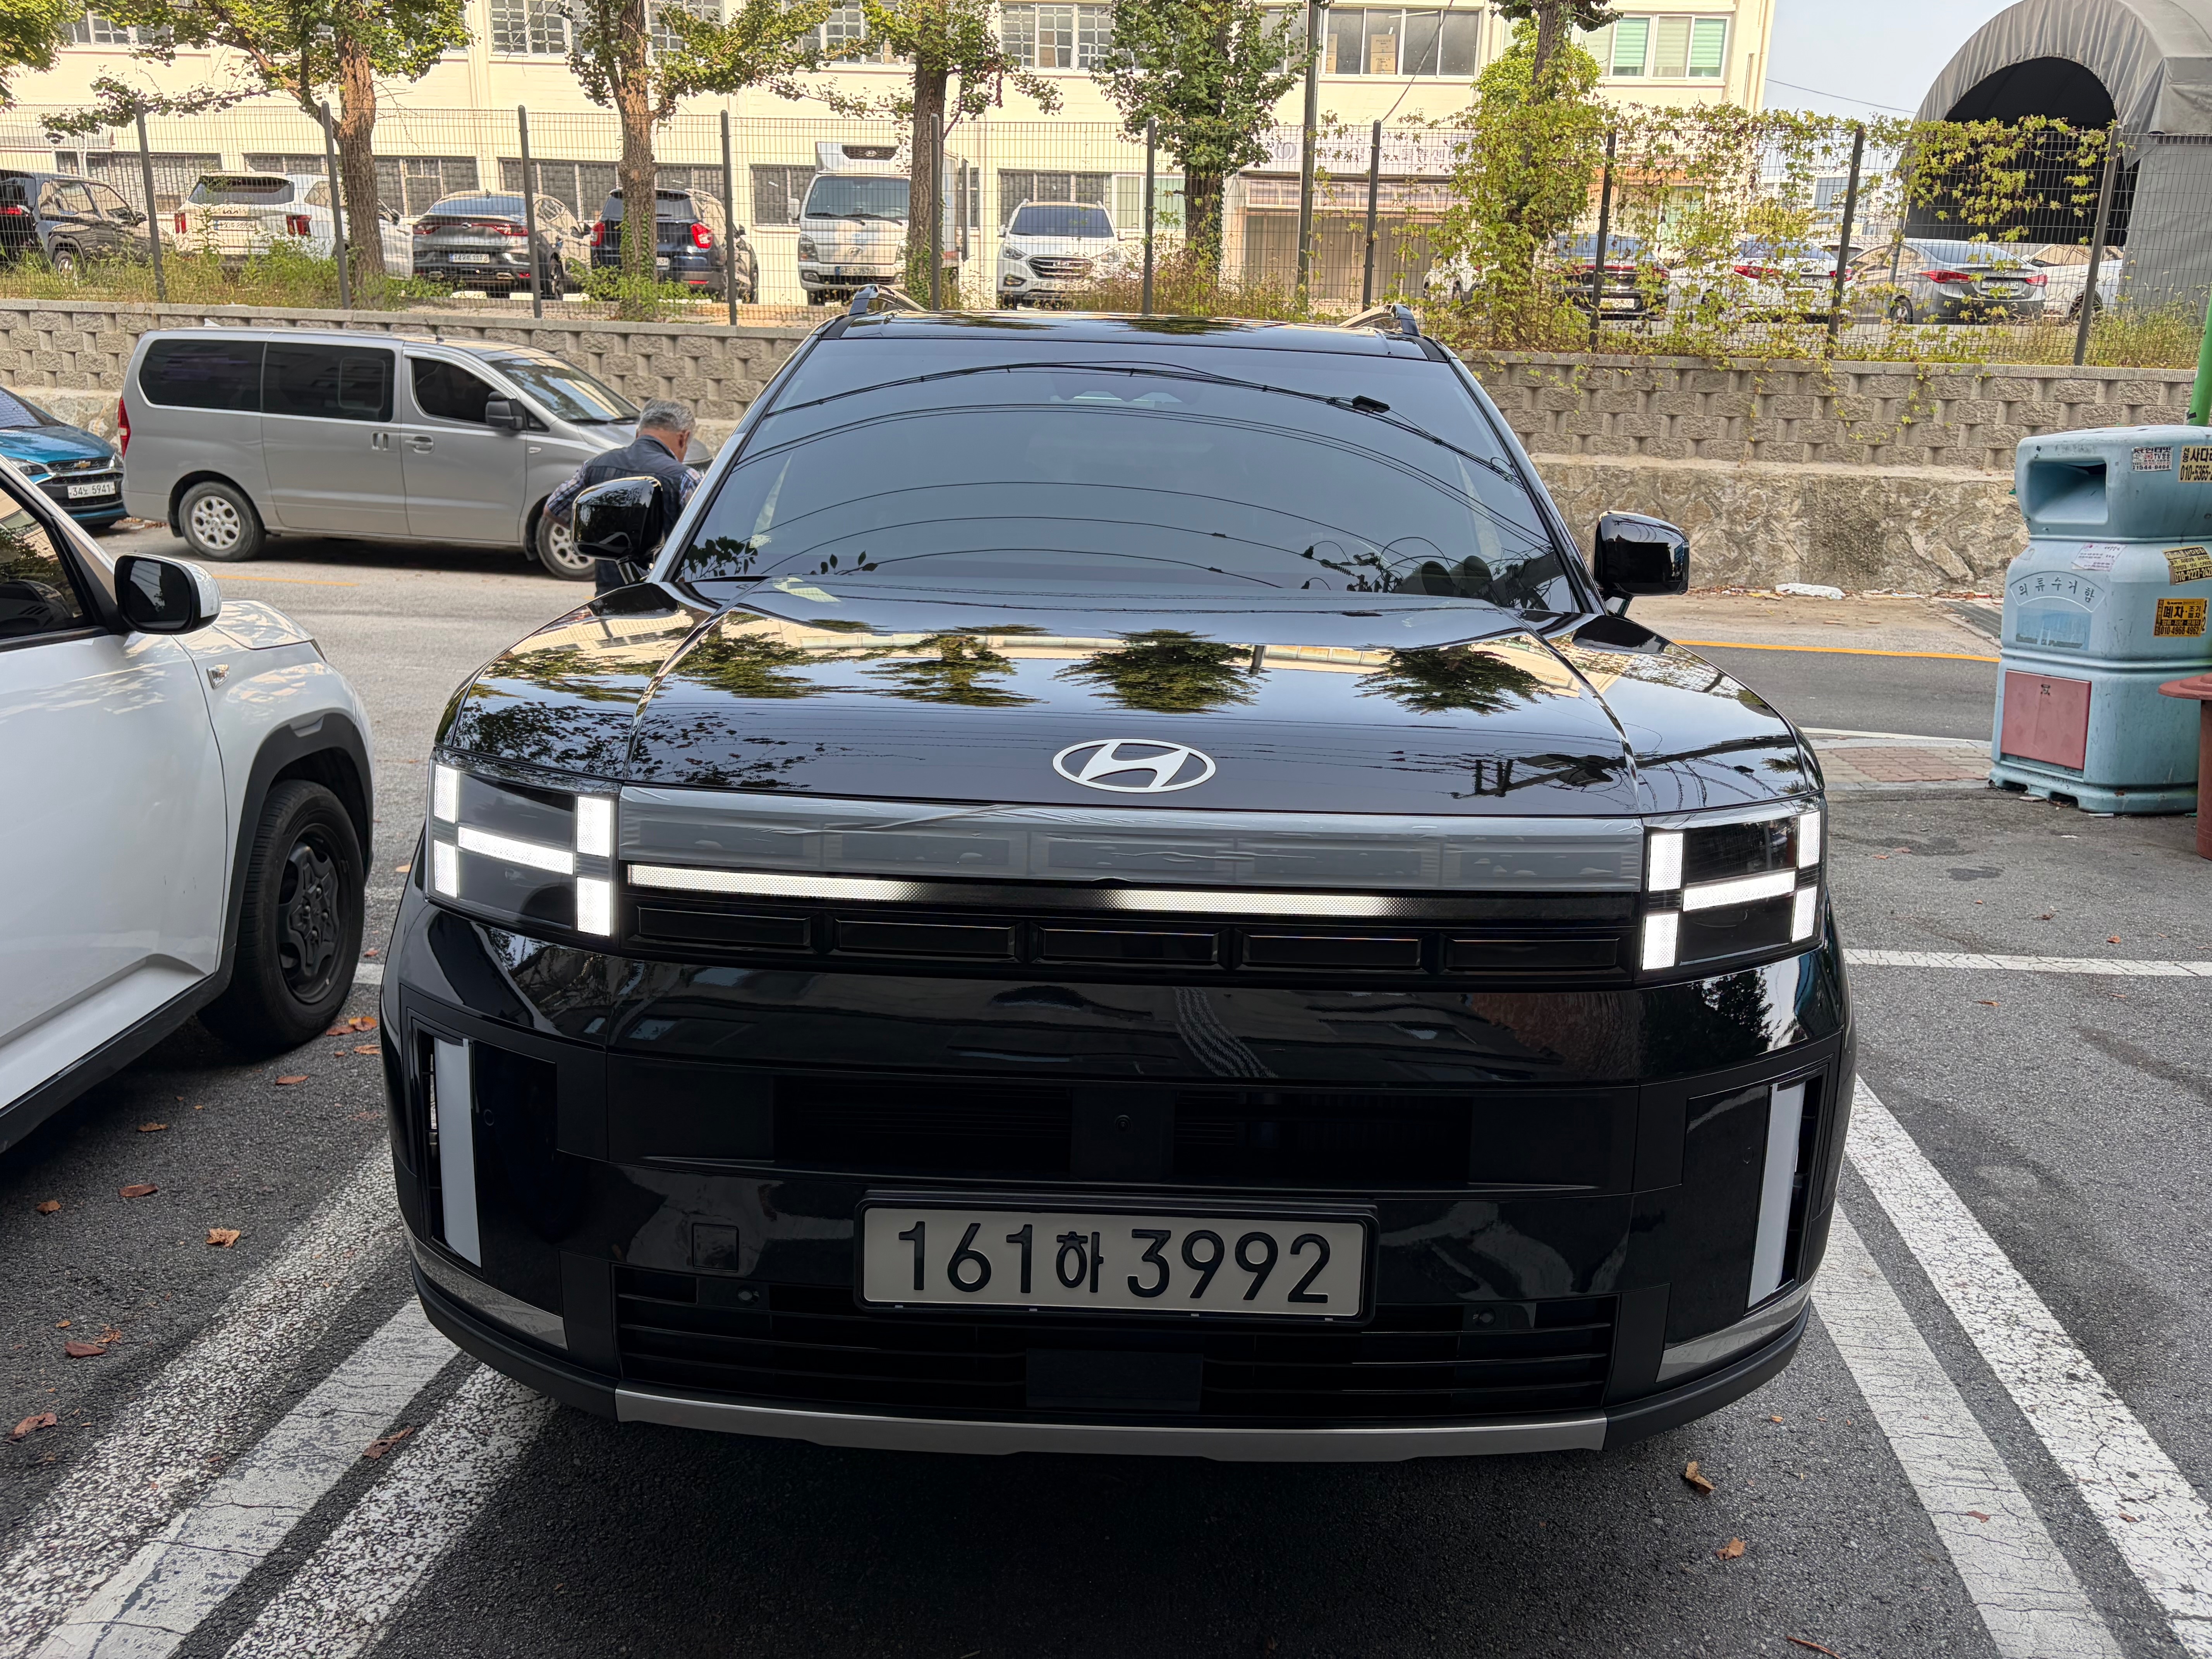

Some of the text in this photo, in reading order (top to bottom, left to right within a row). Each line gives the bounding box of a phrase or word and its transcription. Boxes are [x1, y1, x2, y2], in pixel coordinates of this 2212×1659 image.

[92, 484, 110, 494] 5941
[898, 1221, 1331, 1304] 161하 3992
